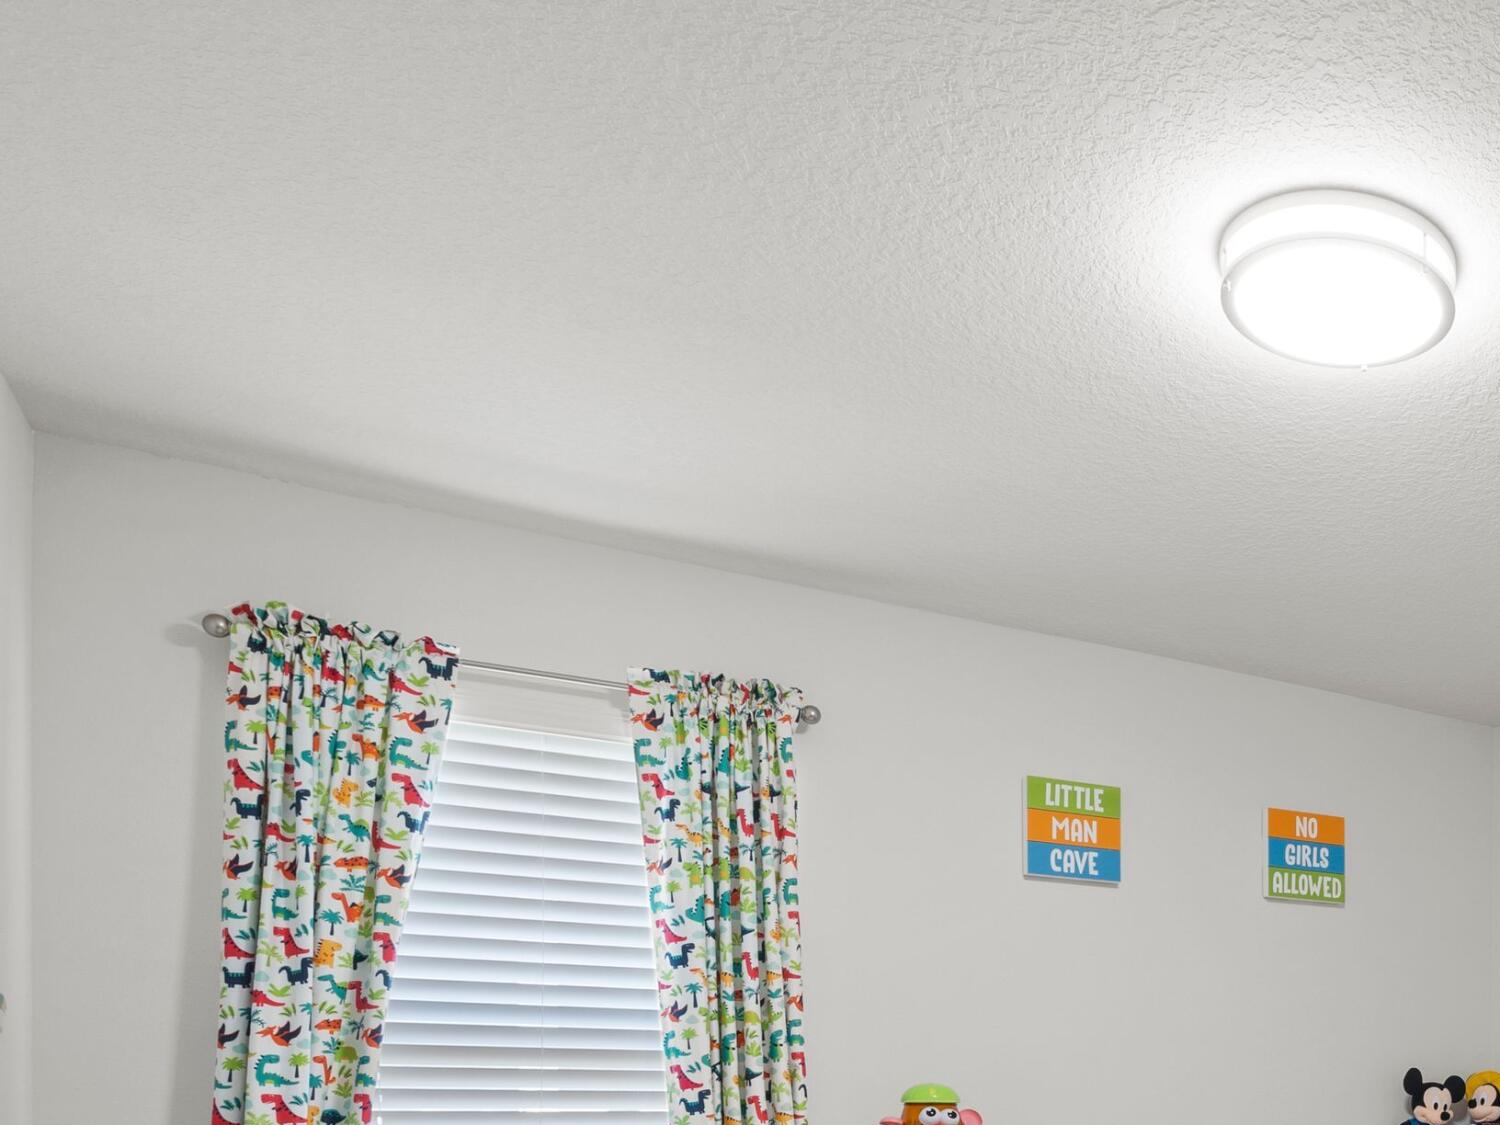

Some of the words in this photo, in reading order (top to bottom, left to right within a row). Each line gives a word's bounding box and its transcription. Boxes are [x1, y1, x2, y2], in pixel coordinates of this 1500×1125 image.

[1045, 782, 1105, 813] LITTLE
[1051, 816, 1098, 845] MAN
[1295, 815, 1319, 839] NO
[1050, 849, 1099, 877] CAVE
[1284, 844, 1330, 869] GIRLS
[1272, 870, 1342, 899] ALLOWED
